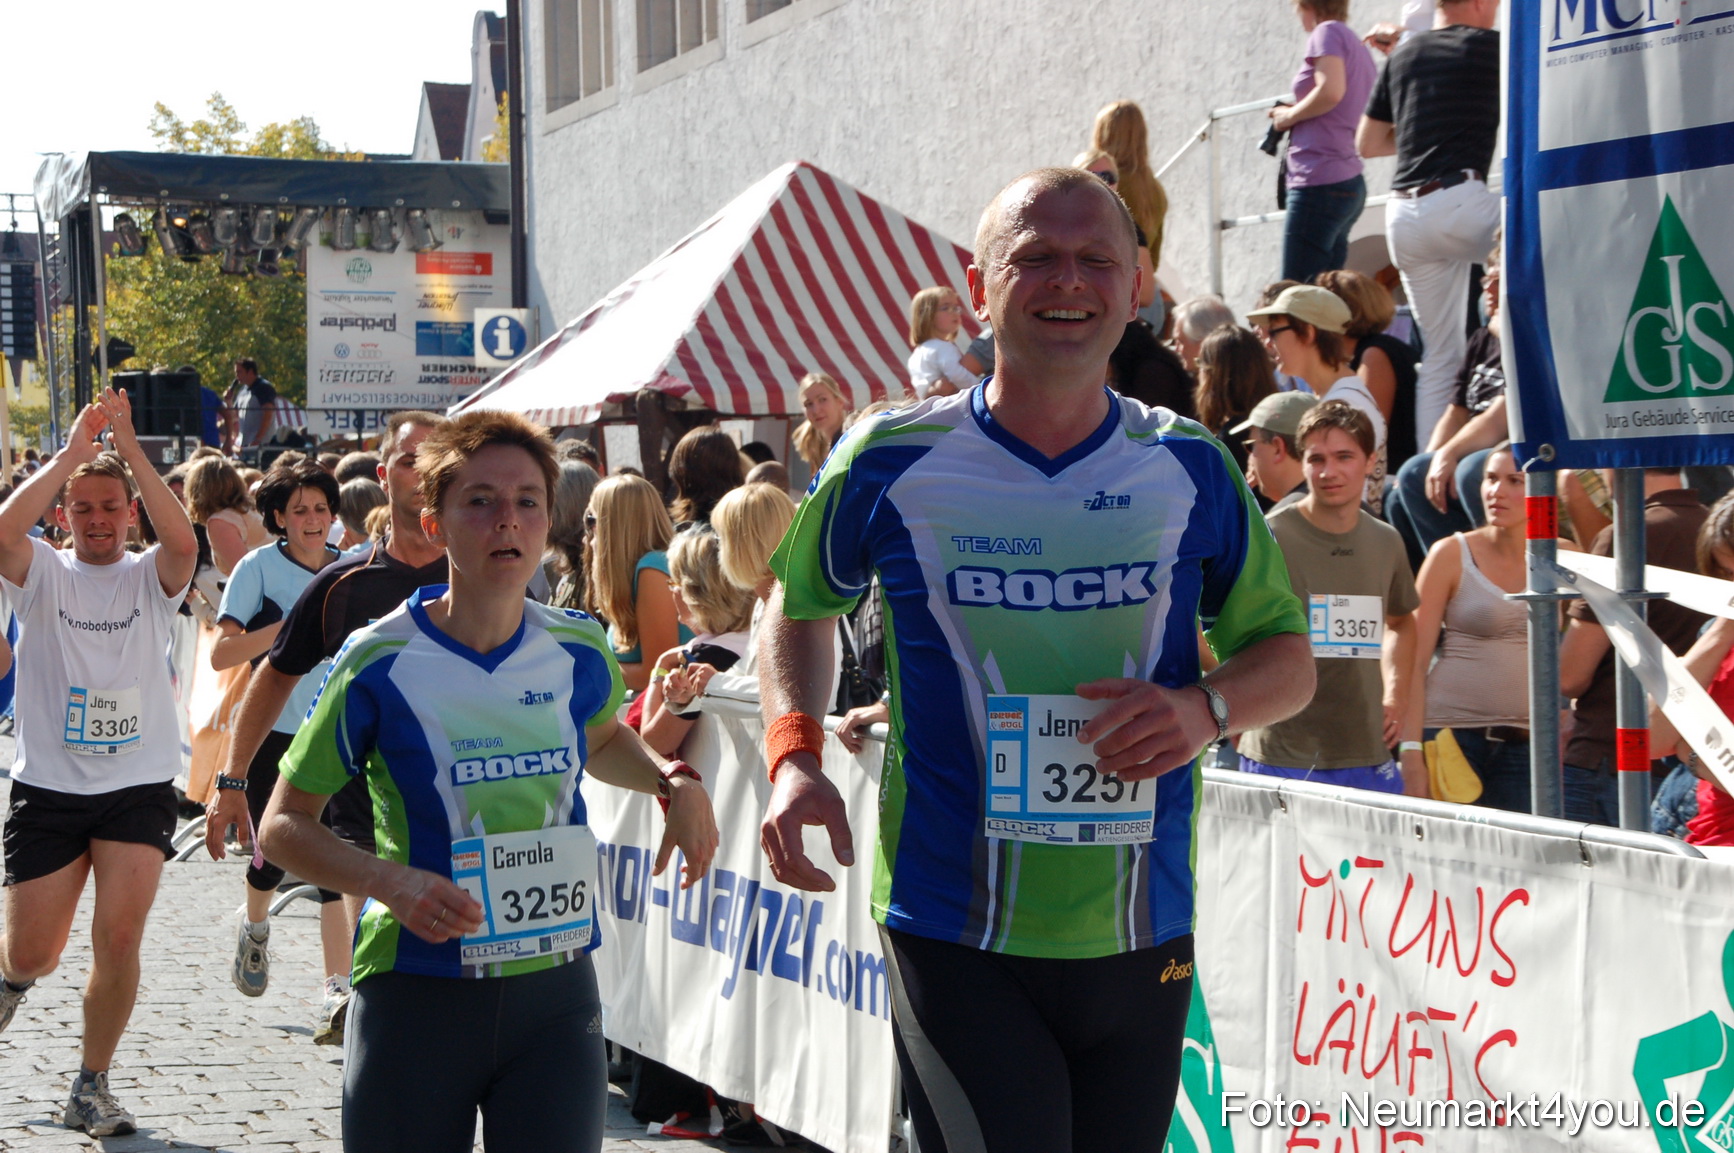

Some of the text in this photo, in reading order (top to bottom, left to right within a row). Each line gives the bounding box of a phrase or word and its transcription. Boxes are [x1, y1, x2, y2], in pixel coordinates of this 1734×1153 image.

[1569, 48, 1608, 63] COMPUTER
[1611, 40, 1654, 55] MANAGING
[1661, 31, 1705, 46] COMPUTER
[353, 294, 393, 304] Neumarkter
[319, 369, 396, 383] FISCHER
[418, 375, 481, 385] INTERSPORT
[322, 393, 457, 404] AKTIENGESELLSCHAFT
[1606, 413, 1629, 429] Jura
[1632, 407, 1690, 428] Gebäude
[951, 535, 1042, 555] TEAM
[946, 560, 1159, 613] BOCK
[1332, 594, 1350, 607] Jan
[1334, 618, 1378, 638] 3367
[90, 695, 117, 712] Jörg
[69, 712, 76, 723] D
[90, 715, 138, 737] 3302
[1039, 709, 1091, 737] Jen
[451, 737, 503, 752] TEAM
[451, 746, 573, 787] BOCK
[995, 753, 1006, 773] D
[987, 819, 1151, 837] BOCK PFLEIDERER
[493, 840, 554, 870] Carola
[501, 880, 588, 923] 3256
[1388, 872, 1530, 987] UNS
[463, 940, 522, 958] BOCK
[552, 926, 591, 945] PFLEIDERER
